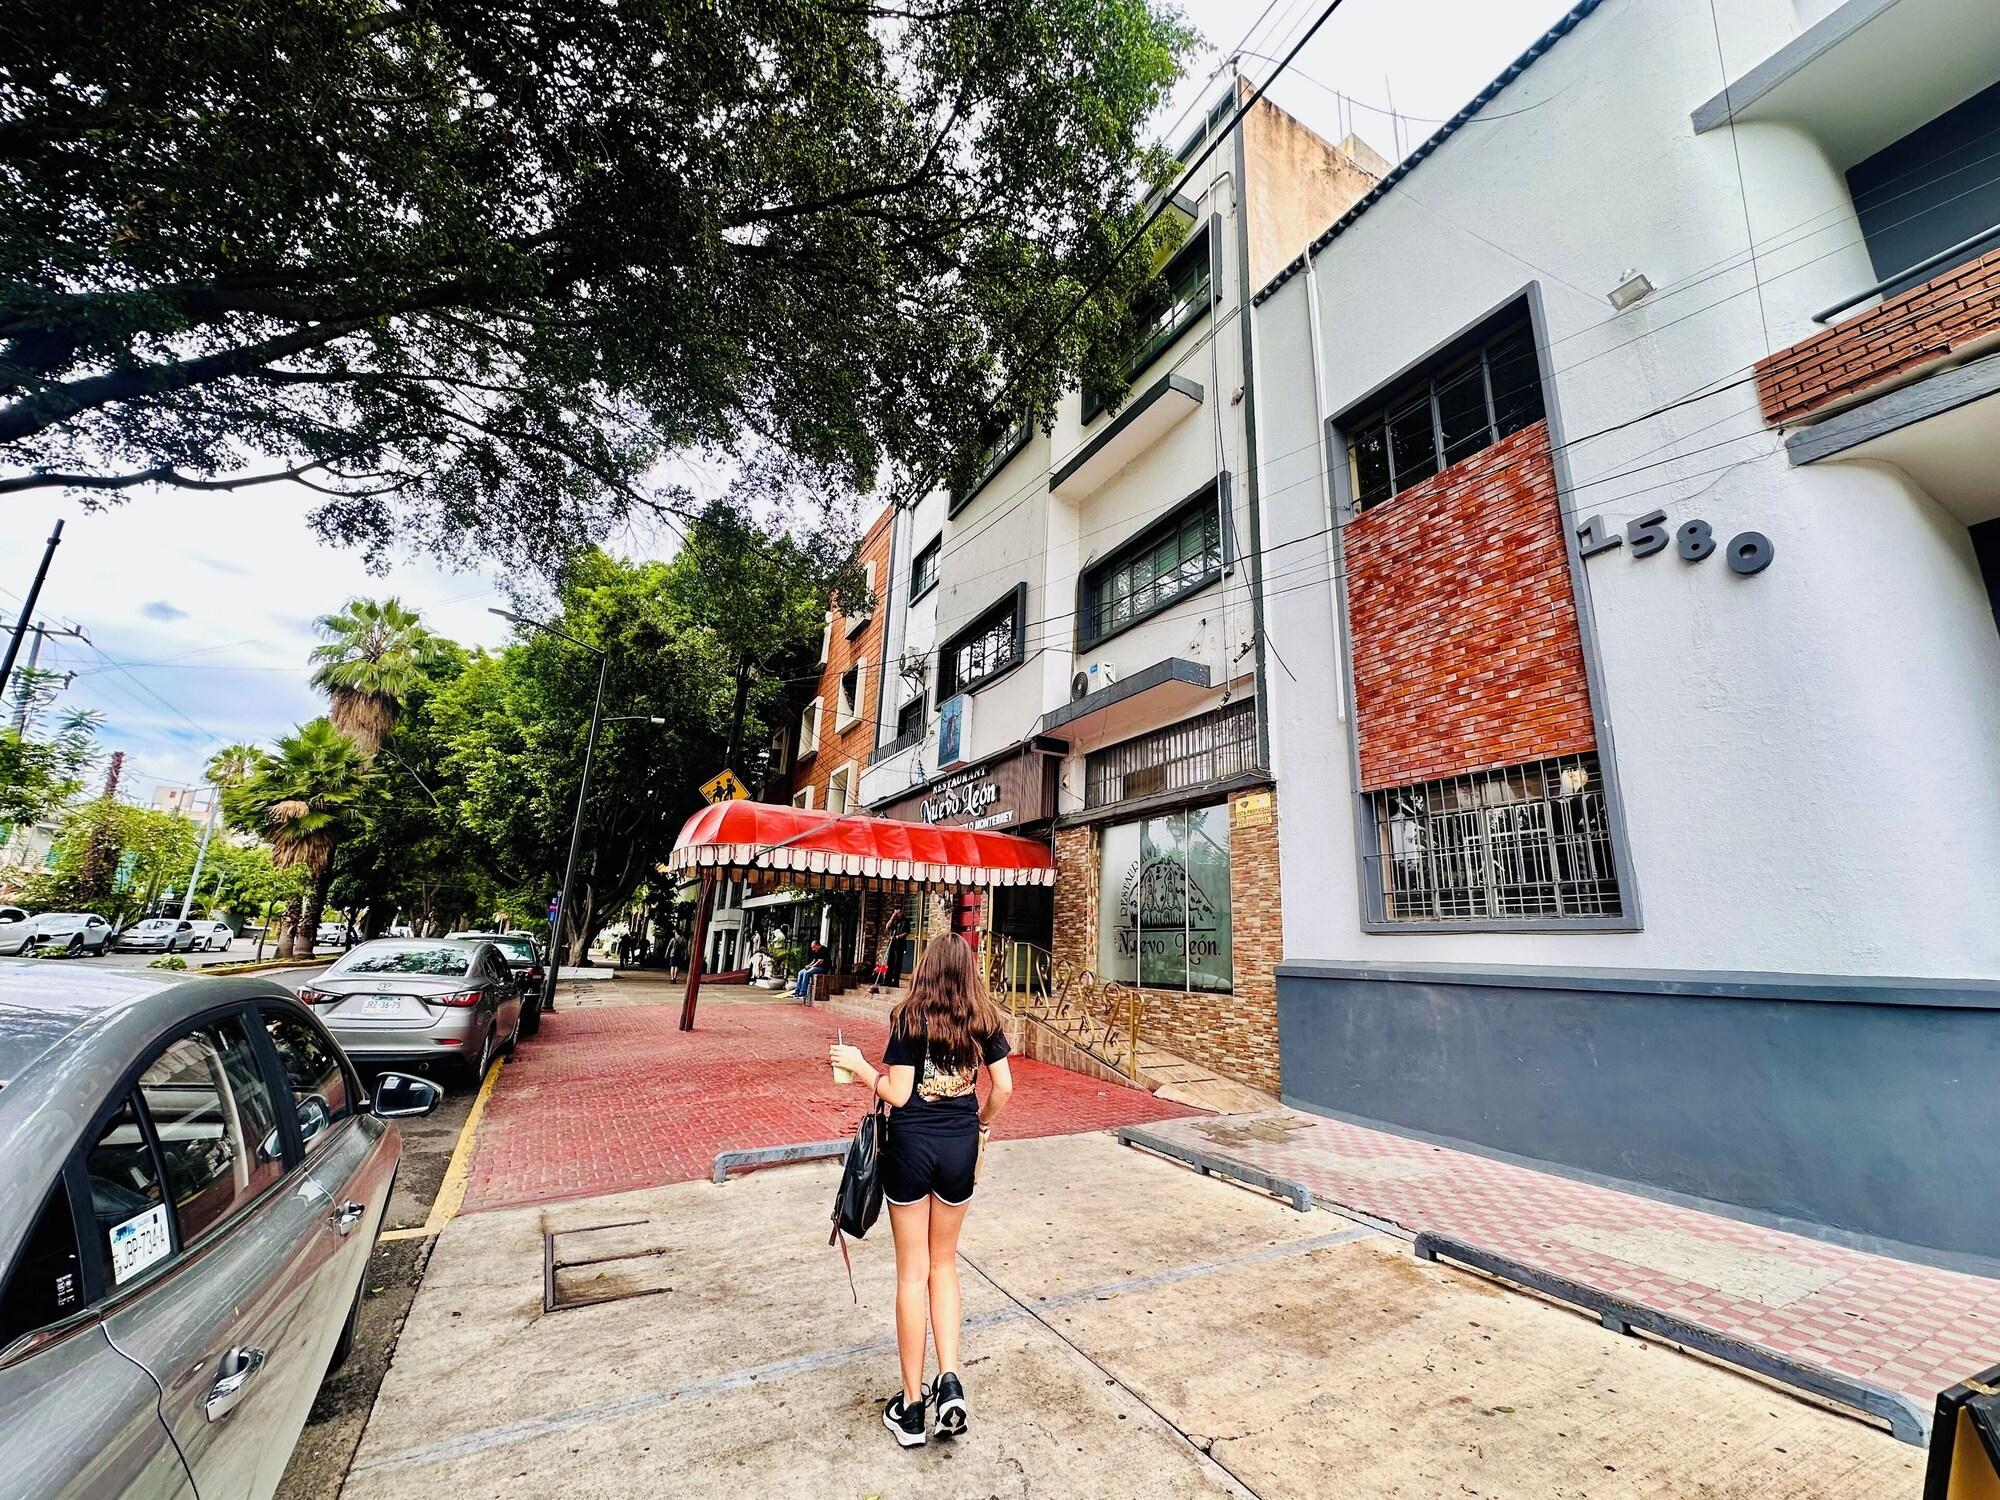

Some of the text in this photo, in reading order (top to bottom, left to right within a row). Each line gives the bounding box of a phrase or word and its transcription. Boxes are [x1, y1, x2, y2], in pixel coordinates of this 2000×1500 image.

[1576, 509, 1775, 576] 1580
[932, 766, 986, 794] RESTAURANT
[919, 781, 996, 825] Nuevo León
[975, 810, 1014, 831] MONTERREY
[1118, 930, 1165, 958] Nuevo
